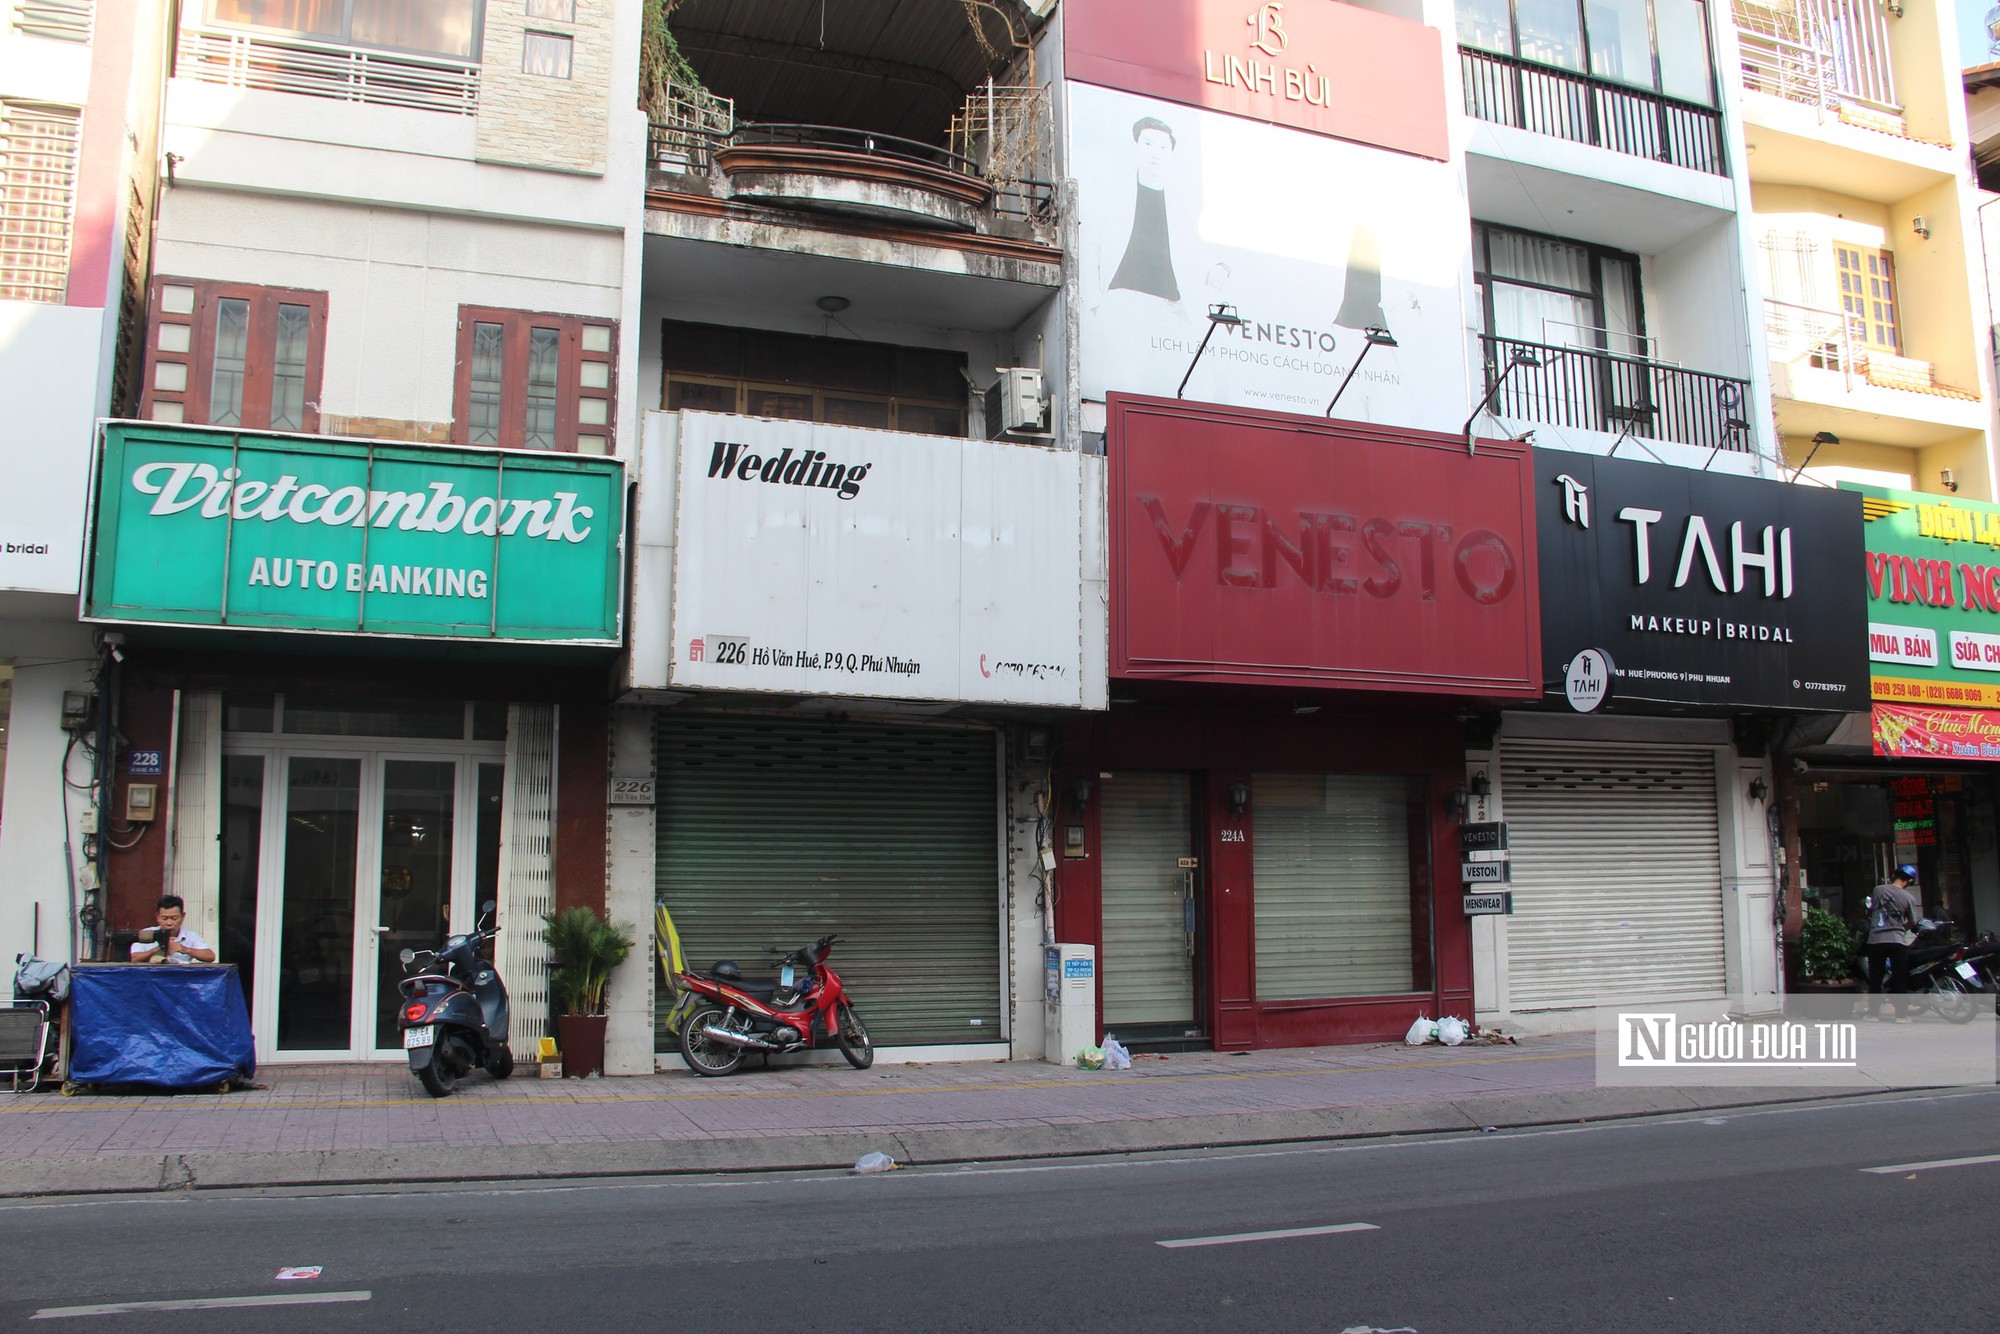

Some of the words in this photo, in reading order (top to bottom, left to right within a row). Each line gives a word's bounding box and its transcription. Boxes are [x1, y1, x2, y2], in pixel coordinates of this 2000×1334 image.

[1206, 50, 1276, 96] LINH
[1285, 64, 1331, 108] BÙI
[1224, 319, 1336, 352] VENESTO
[1220, 347, 1269, 366] PHONG
[1273, 354, 1309, 372] CÁCH
[1314, 362, 1360, 379] DOANH
[1364, 370, 1400, 385] NHÂN
[1244, 388, 1320, 406] www.venesto.vn
[707, 441, 872, 500] Wedding
[132, 463, 594, 543] Vietcombank
[6, 542, 49, 555] bridal
[1136, 496, 1517, 606] VENESTO
[1619, 507, 1793, 599] TAHI
[249, 557, 339, 590] AUTO
[346, 562, 488, 599] BANKING
[1865, 551, 1955, 607] VINH
[716, 641, 747, 664] 226
[752, 646, 770, 666] Hồ
[772, 649, 793, 667] Văn
[861, 654, 883, 672] Phú
[885, 656, 921, 677] Nhuận
[1869, 633, 1900, 656] MUA
[1904, 634, 1932, 659] BÁN
[1955, 636, 1981, 662] SỬA
[1573, 679, 1600, 693] TAHI
[1874, 682, 1891, 695] 0919
[132, 752, 159, 766] 228
[1952, 741, 1979, 756] Xuân
[615, 781, 652, 793] 226
[1221, 829, 1245, 842] 224A
[1463, 831, 1496, 842] VENESTO
[1466, 866, 1497, 877] VESTON
[1465, 898, 1501, 910] MENSWEAR
